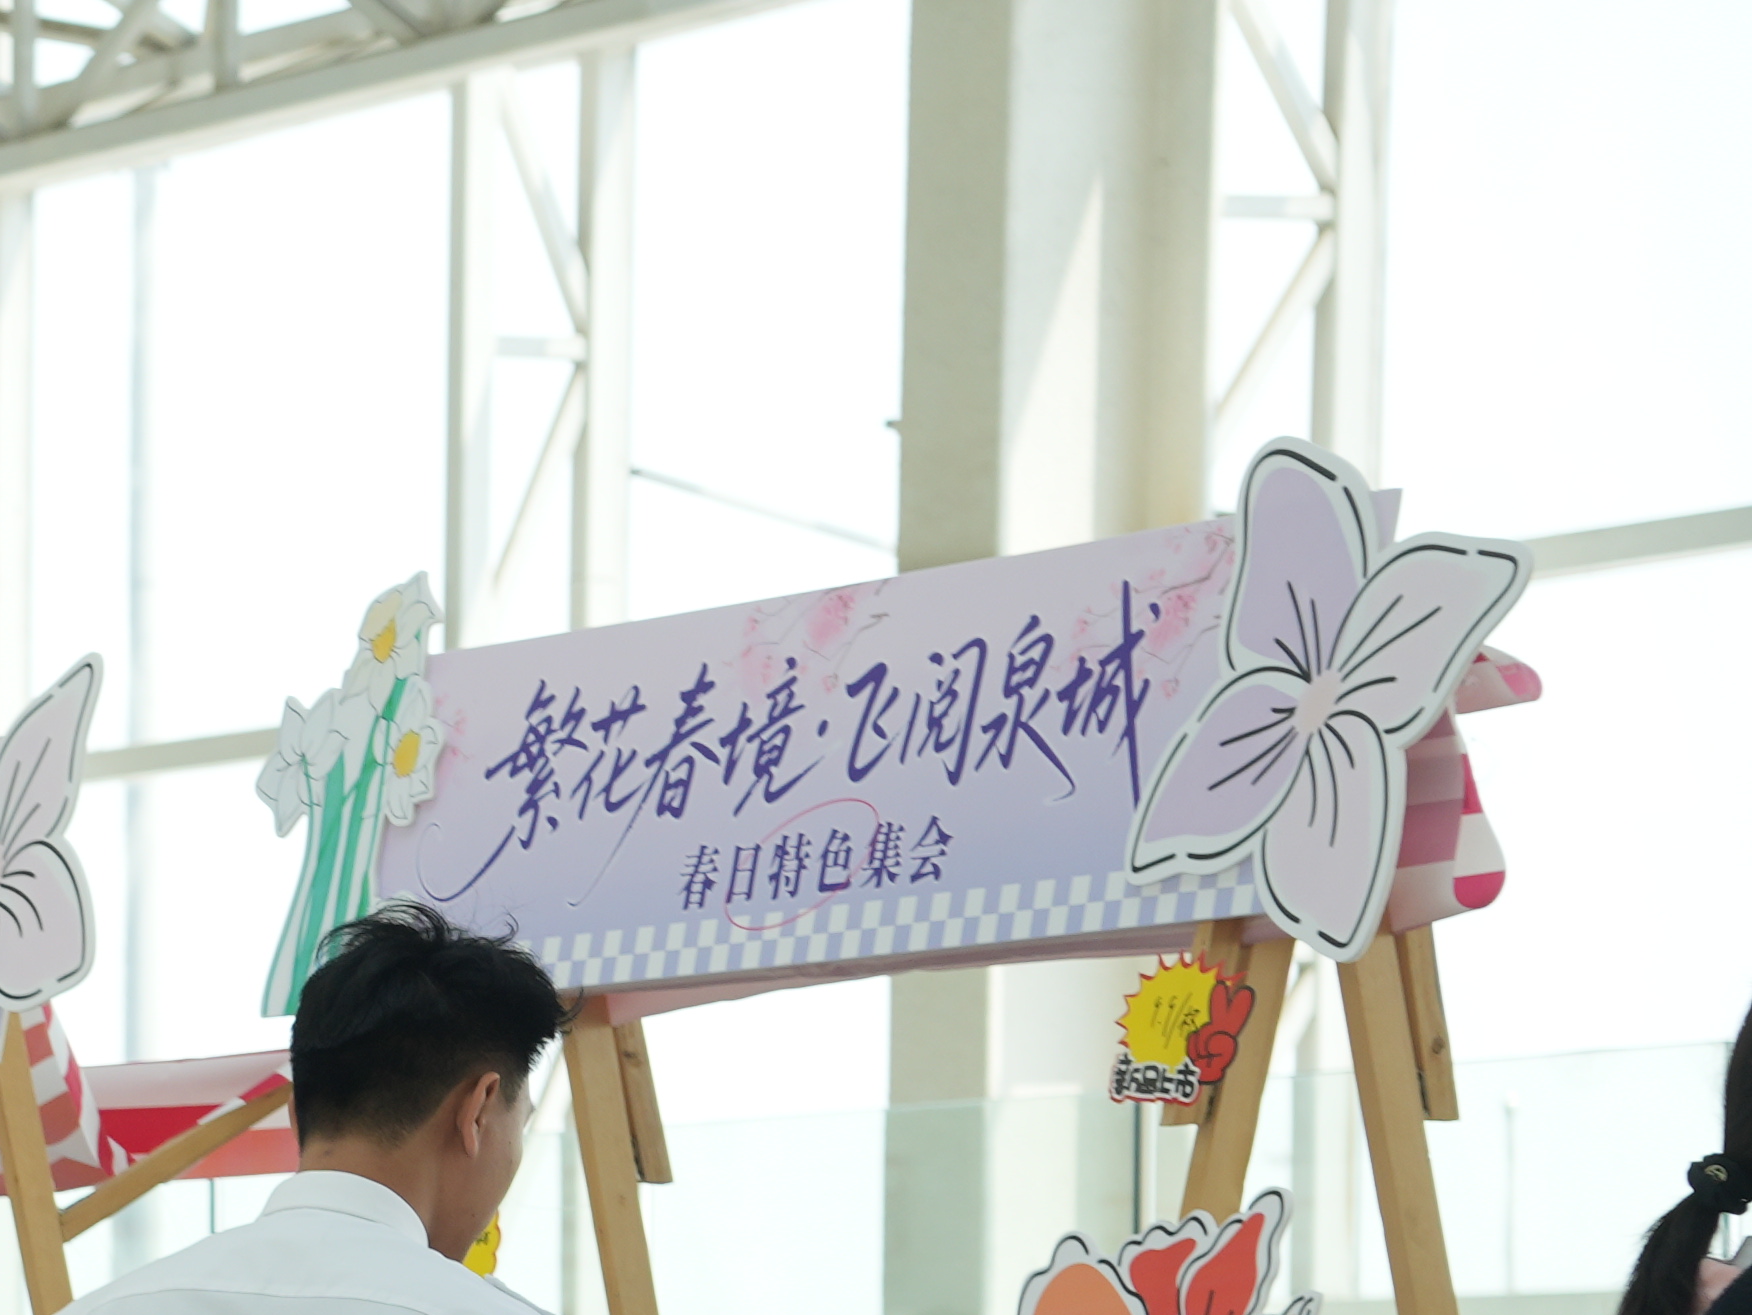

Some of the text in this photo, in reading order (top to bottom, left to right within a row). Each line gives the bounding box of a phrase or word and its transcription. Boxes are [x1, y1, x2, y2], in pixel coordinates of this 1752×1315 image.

[679, 816, 956, 910] 春日特色集会
